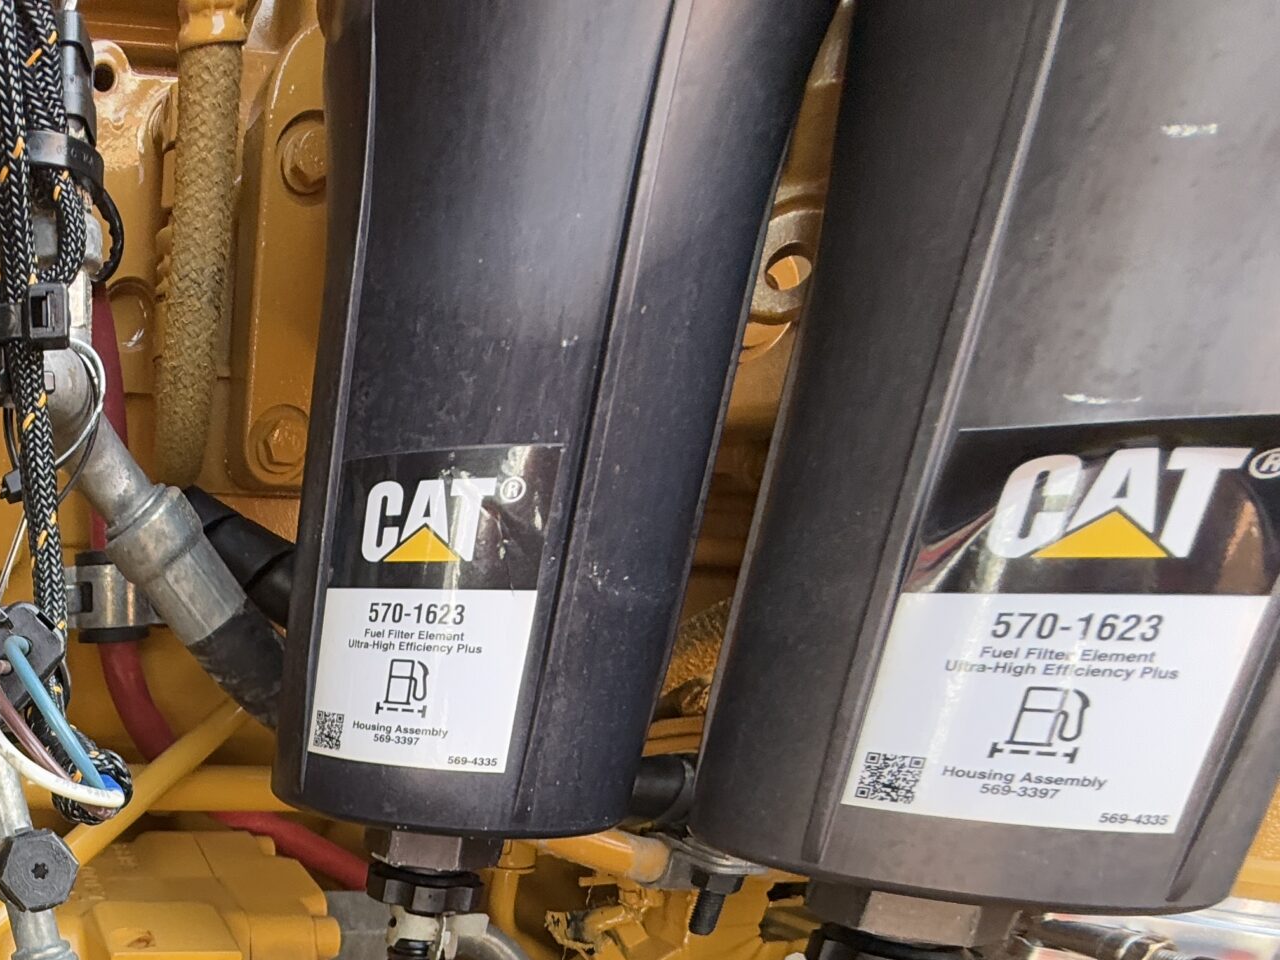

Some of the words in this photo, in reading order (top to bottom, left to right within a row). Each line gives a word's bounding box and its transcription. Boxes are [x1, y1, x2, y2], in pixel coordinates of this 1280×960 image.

[368, 602, 466, 625] 570-1623
[364, 628, 385, 638] Fuel
[388, 629, 415, 640] Filter
[418, 630, 465, 642] Element
[991, 612, 1164, 642] 570-1623
[348, 639, 395, 652] Ultra-High
[398, 641, 453, 655] Efficiency
[456, 643, 483, 654] Plus
[979, 646, 1020, 659] Fuel
[1024, 647, 1074, 661] Filter
[1080, 649, 1157, 663] Element
[945, 659, 1036, 677] Ultra-High
[1042, 663, 1135, 681] Efficiency
[1140, 667, 1180, 680] Plus
[352, 720, 392, 734] Housing
[394, 725, 449, 739] Assembly
[373, 734, 420, 746] 569-3397
[447, 755, 498, 766] 569-4335
[941, 765, 1015, 784] Housing
[1020, 772, 1108, 790] Assembly
[979, 783, 1060, 799] 569-3397
[1098, 812, 1169, 826] 569-4335
